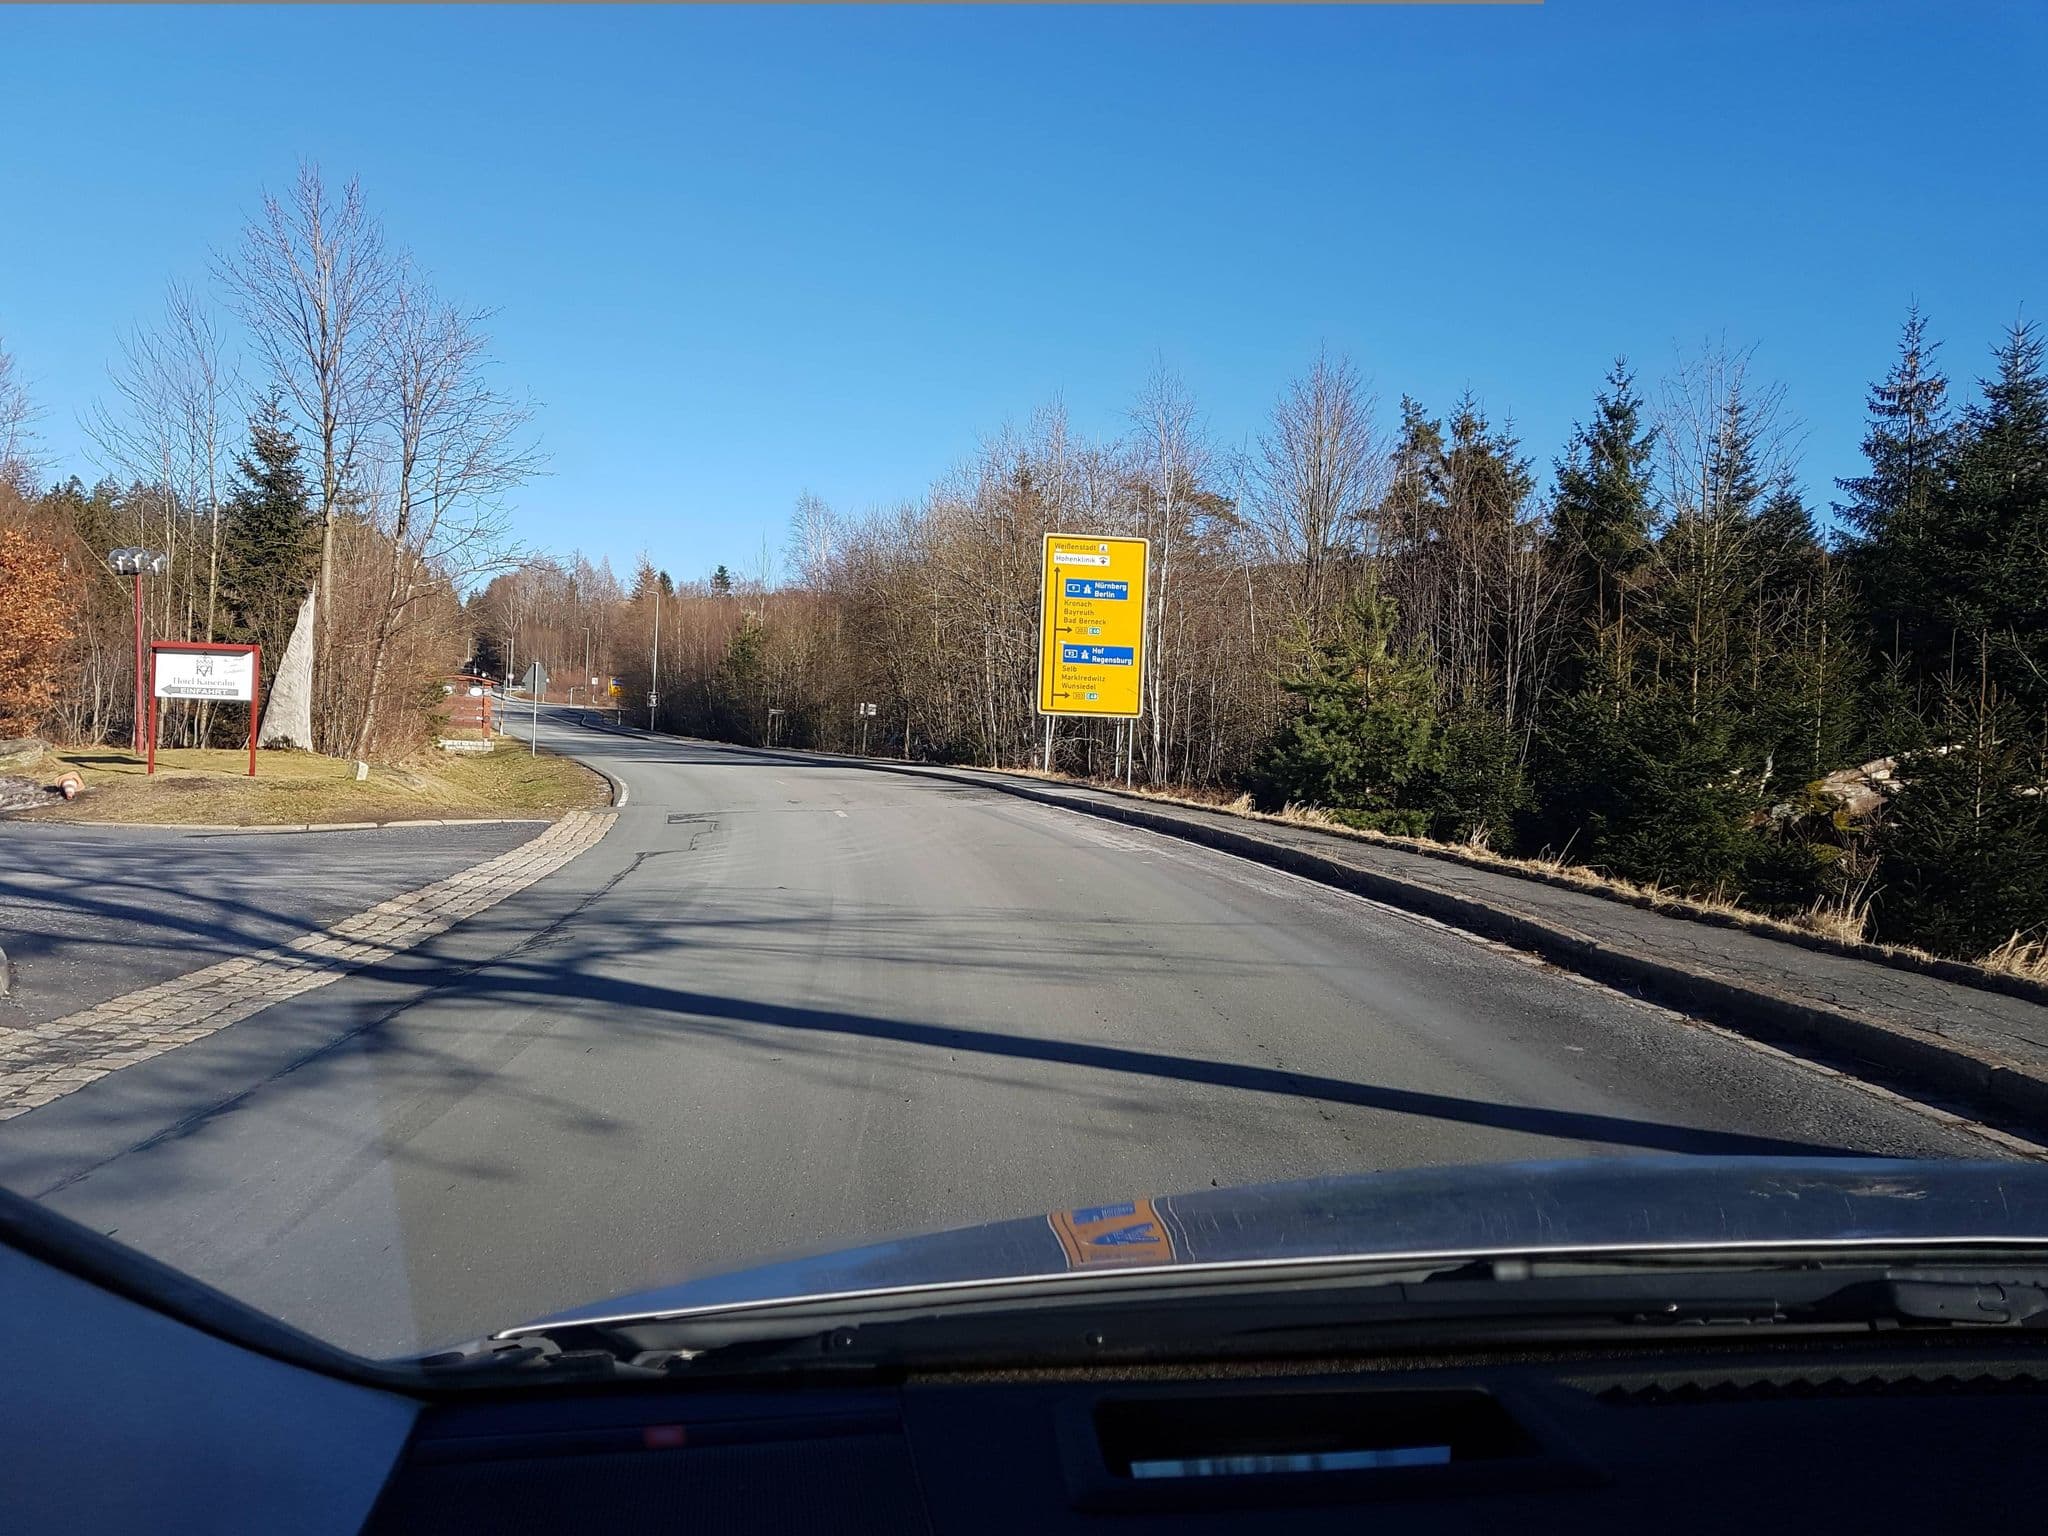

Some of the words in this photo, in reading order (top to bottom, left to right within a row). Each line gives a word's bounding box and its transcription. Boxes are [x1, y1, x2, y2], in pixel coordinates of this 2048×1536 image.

[1094, 581, 1127, 592] Nürnberg
[1064, 600, 1092, 608] Kronach
[1063, 608, 1095, 616] Bayreuth
[1092, 647, 1105, 655] Hof
[1091, 656, 1132, 666] Regensburg
[173, 677, 195, 685] Hotel
[1061, 674, 1105, 682] Marktredwitz
[180, 687, 228, 696] EINFAHRT
